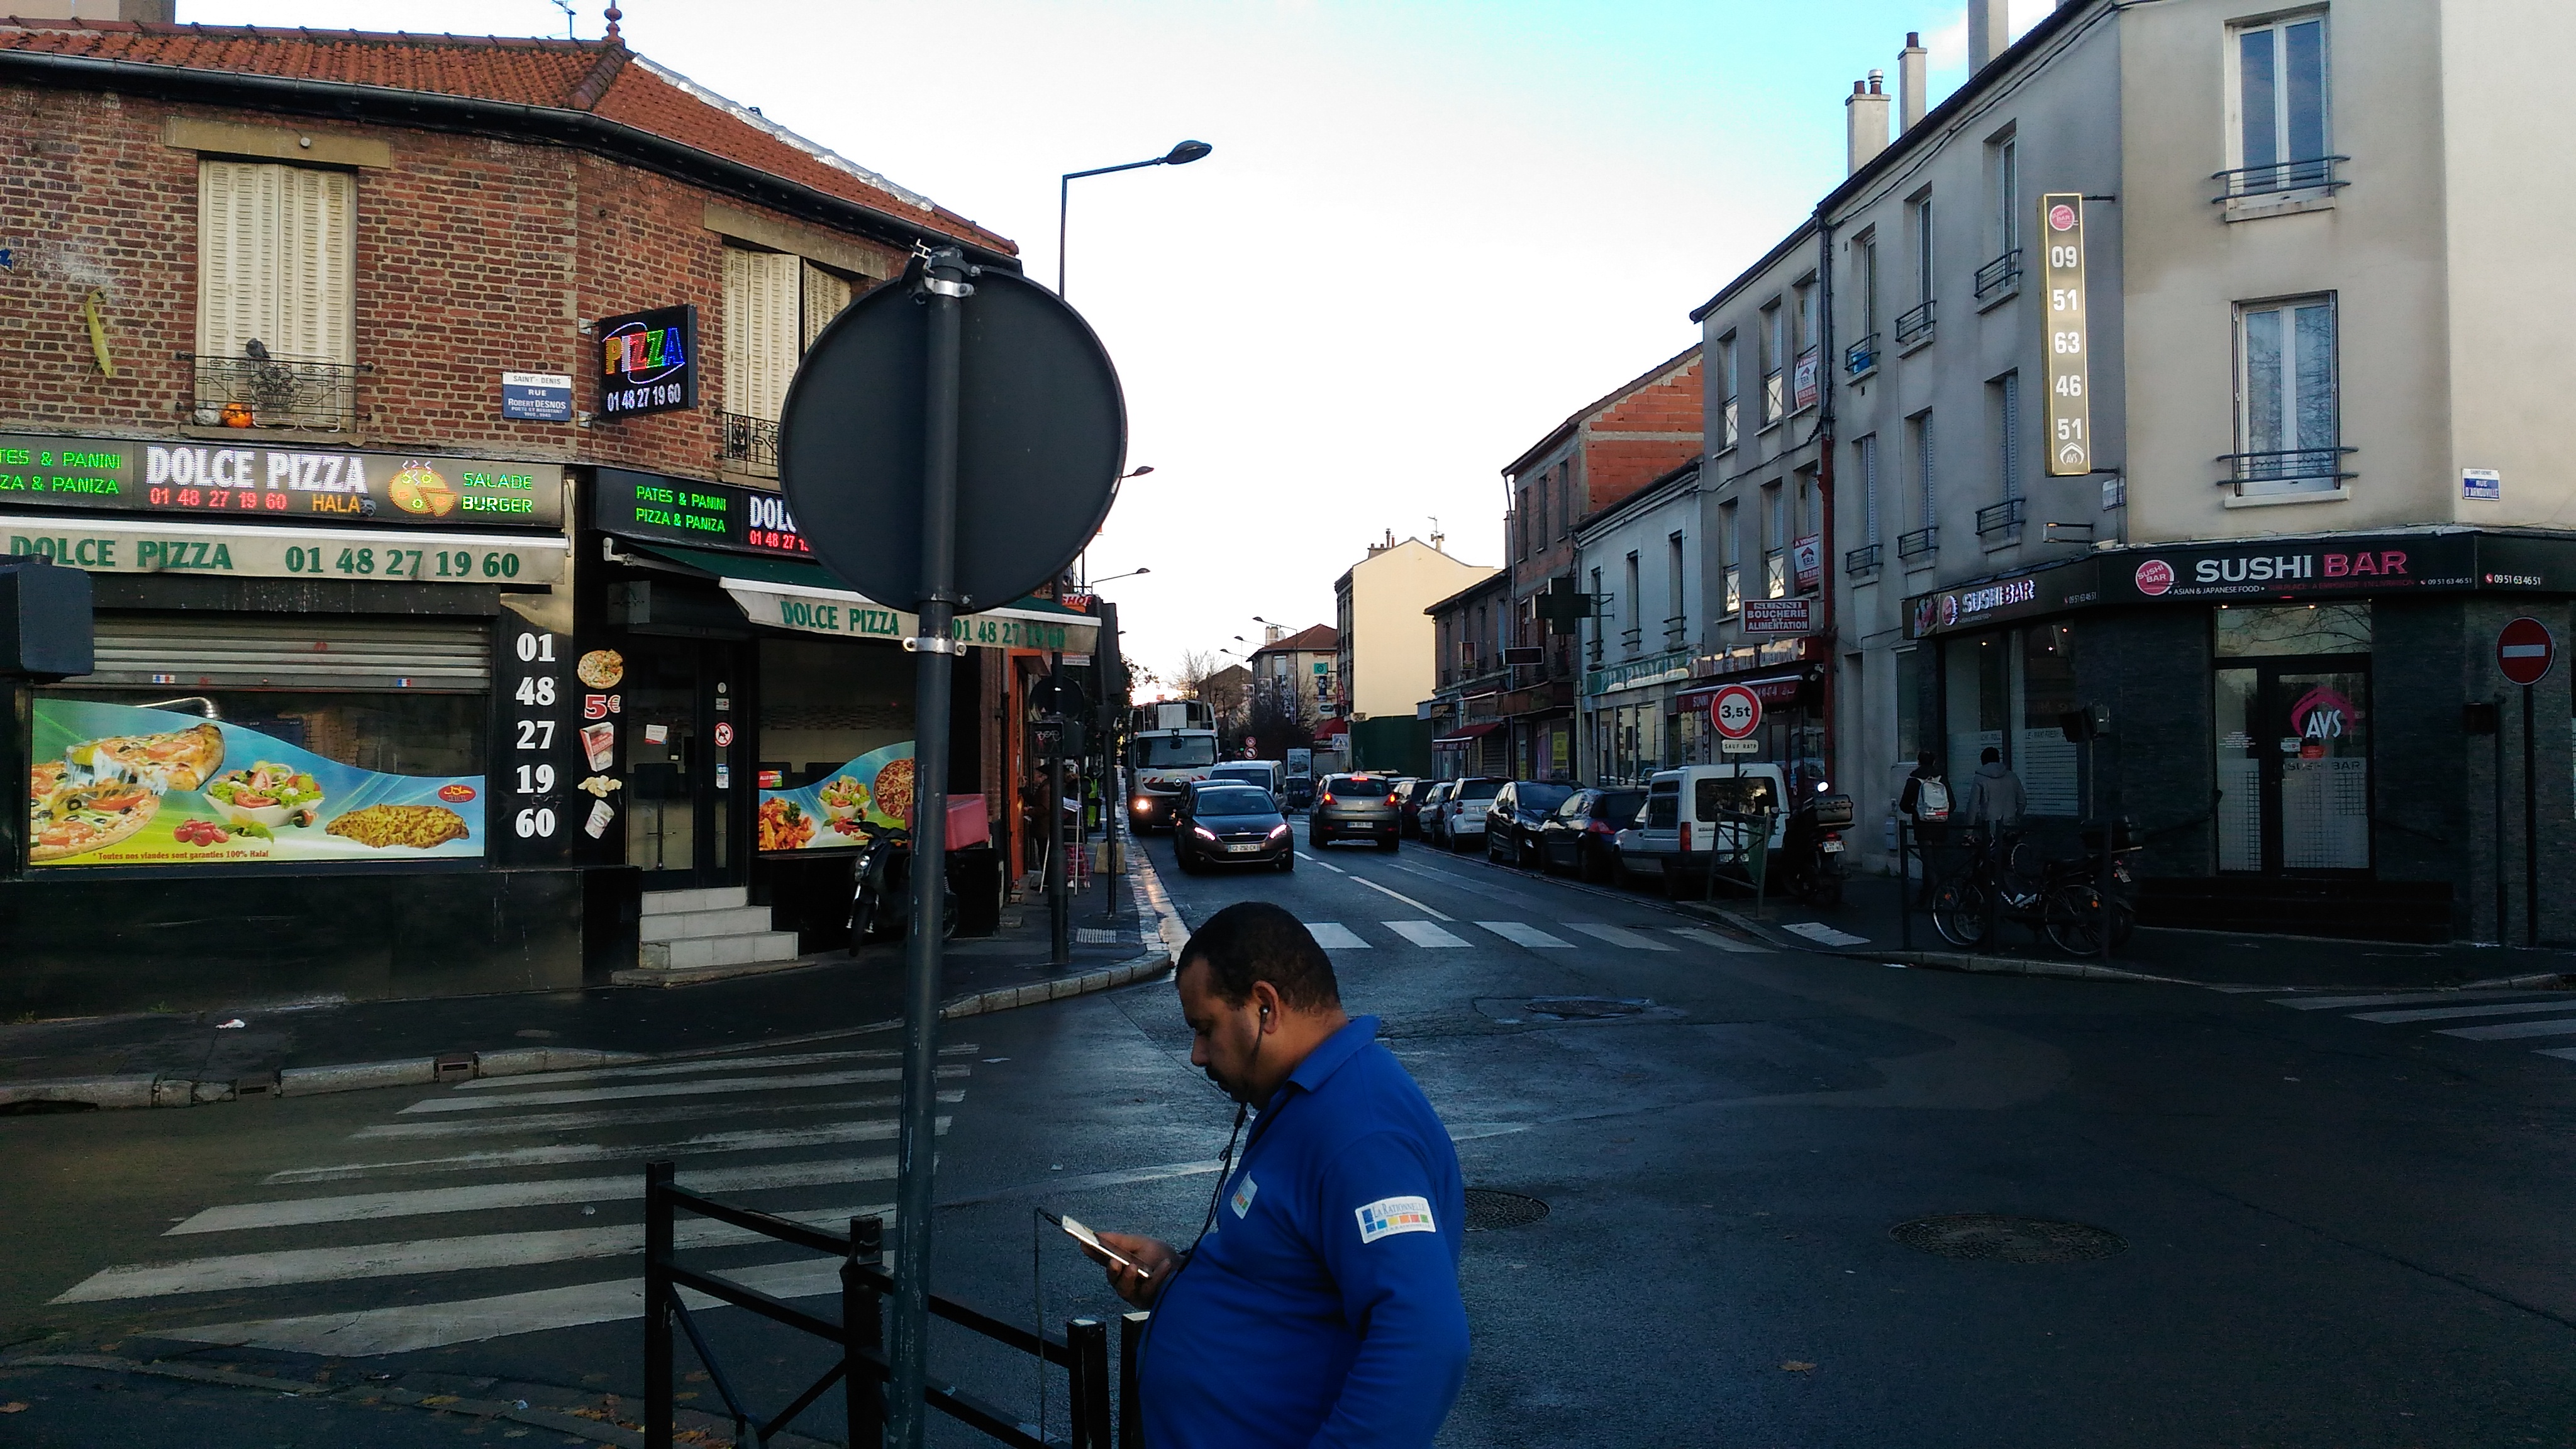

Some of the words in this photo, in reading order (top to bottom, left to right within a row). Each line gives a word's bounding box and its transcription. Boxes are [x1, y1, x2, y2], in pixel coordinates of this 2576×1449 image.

[2051, 246, 2077, 268] 09
[2053, 289, 2077, 311] 51
[606, 327, 684, 374] PIZZA
[2055, 332, 2080, 353] 63
[2056, 375, 2082, 396] 46
[535, 399, 566, 409] DESNOS
[608, 391, 619, 412] 01
[622, 390, 635, 410] 48
[637, 387, 650, 408] 27
[653, 385, 665, 406] 19
[667, 382, 681, 403] 60
[2058, 418, 2082, 440] 51
[40, 451, 53, 467] &
[64, 452, 121, 469] PANINI
[146, 445, 255, 488] DOLCE
[267, 452, 368, 494] PIZZA
[2066, 453, 2077, 464] AVS
[32, 475, 45, 491] &
[53, 477, 119, 495] PANIZA
[463, 472, 533, 490] SALADE
[150, 487, 169, 505] 01
[177, 488, 200, 506] 48
[209, 490, 230, 508] 27
[238, 492, 257, 509] 19
[266, 493, 287, 510] 60
[312, 494, 360, 513] HALA
[463, 496, 533, 513] BURGER
[636, 485, 674, 503] PATES
[679, 492, 686, 506] &
[692, 493, 726, 511] PANINI
[636, 508, 670, 526] PIZZA
[674, 513, 682, 526] &
[686, 514, 726, 533] PANIZA
[749, 494, 797, 533] DOL
[749, 530, 762, 545] 01
[765, 532, 779, 548] 48
[783, 535, 796, 550] 27
[799, 538, 809, 552] 1
[11, 536, 116, 565] DOLCE
[137, 541, 233, 570] PIZZA
[286, 546, 323, 574] 01
[336, 548, 375, 574] 48
[386, 550, 423, 576] 27
[436, 551, 472, 577] 19
[483, 552, 519, 578] 60
[2138, 564, 2164, 580] SUSHI
[2196, 555, 2311, 582] SUSHI
[2324, 551, 2408, 577] BAR
[2146, 574, 2167, 583] BAR
[2494, 575, 2503, 584] 09
[2504, 575, 2512, 584] 51
[2514, 575, 2522, 584] 63
[2523, 576, 2532, 585] 46
[2533, 577, 2541, 586] 51
[1962, 586, 2002, 614] SUSHI
[2004, 579, 2036, 604] BAR
[2174, 587, 2194, 595] ASIAN
[2202, 586, 2237, 594] JAPANESE
[781, 601, 838, 630] DOLCE
[850, 608, 899, 636] PIZZA
[1747, 609, 1807, 618] BOUCHERIE
[953, 618, 973, 641] 01
[978, 621, 997, 643] 48
[1002, 623, 1020, 645] 27
[1026, 626, 1044, 647] 19
[1048, 628, 1065, 648] 60
[1748, 620, 1808, 630] ALIMENTATION
[516, 632, 556, 662] 01
[516, 677, 556, 706] 48
[584, 694, 621, 719] 5€
[1721, 705, 1750, 718] 3,5t
[516, 720, 555, 750] 27
[2306, 709, 2343, 739] AVS
[516, 764, 555, 794] 19
[516, 808, 556, 838] 60
[189, 851, 224, 860] garanties
[1372, 1207, 1382, 1218] LA
[1382, 1202, 1425, 1214] RATIONNELLE
